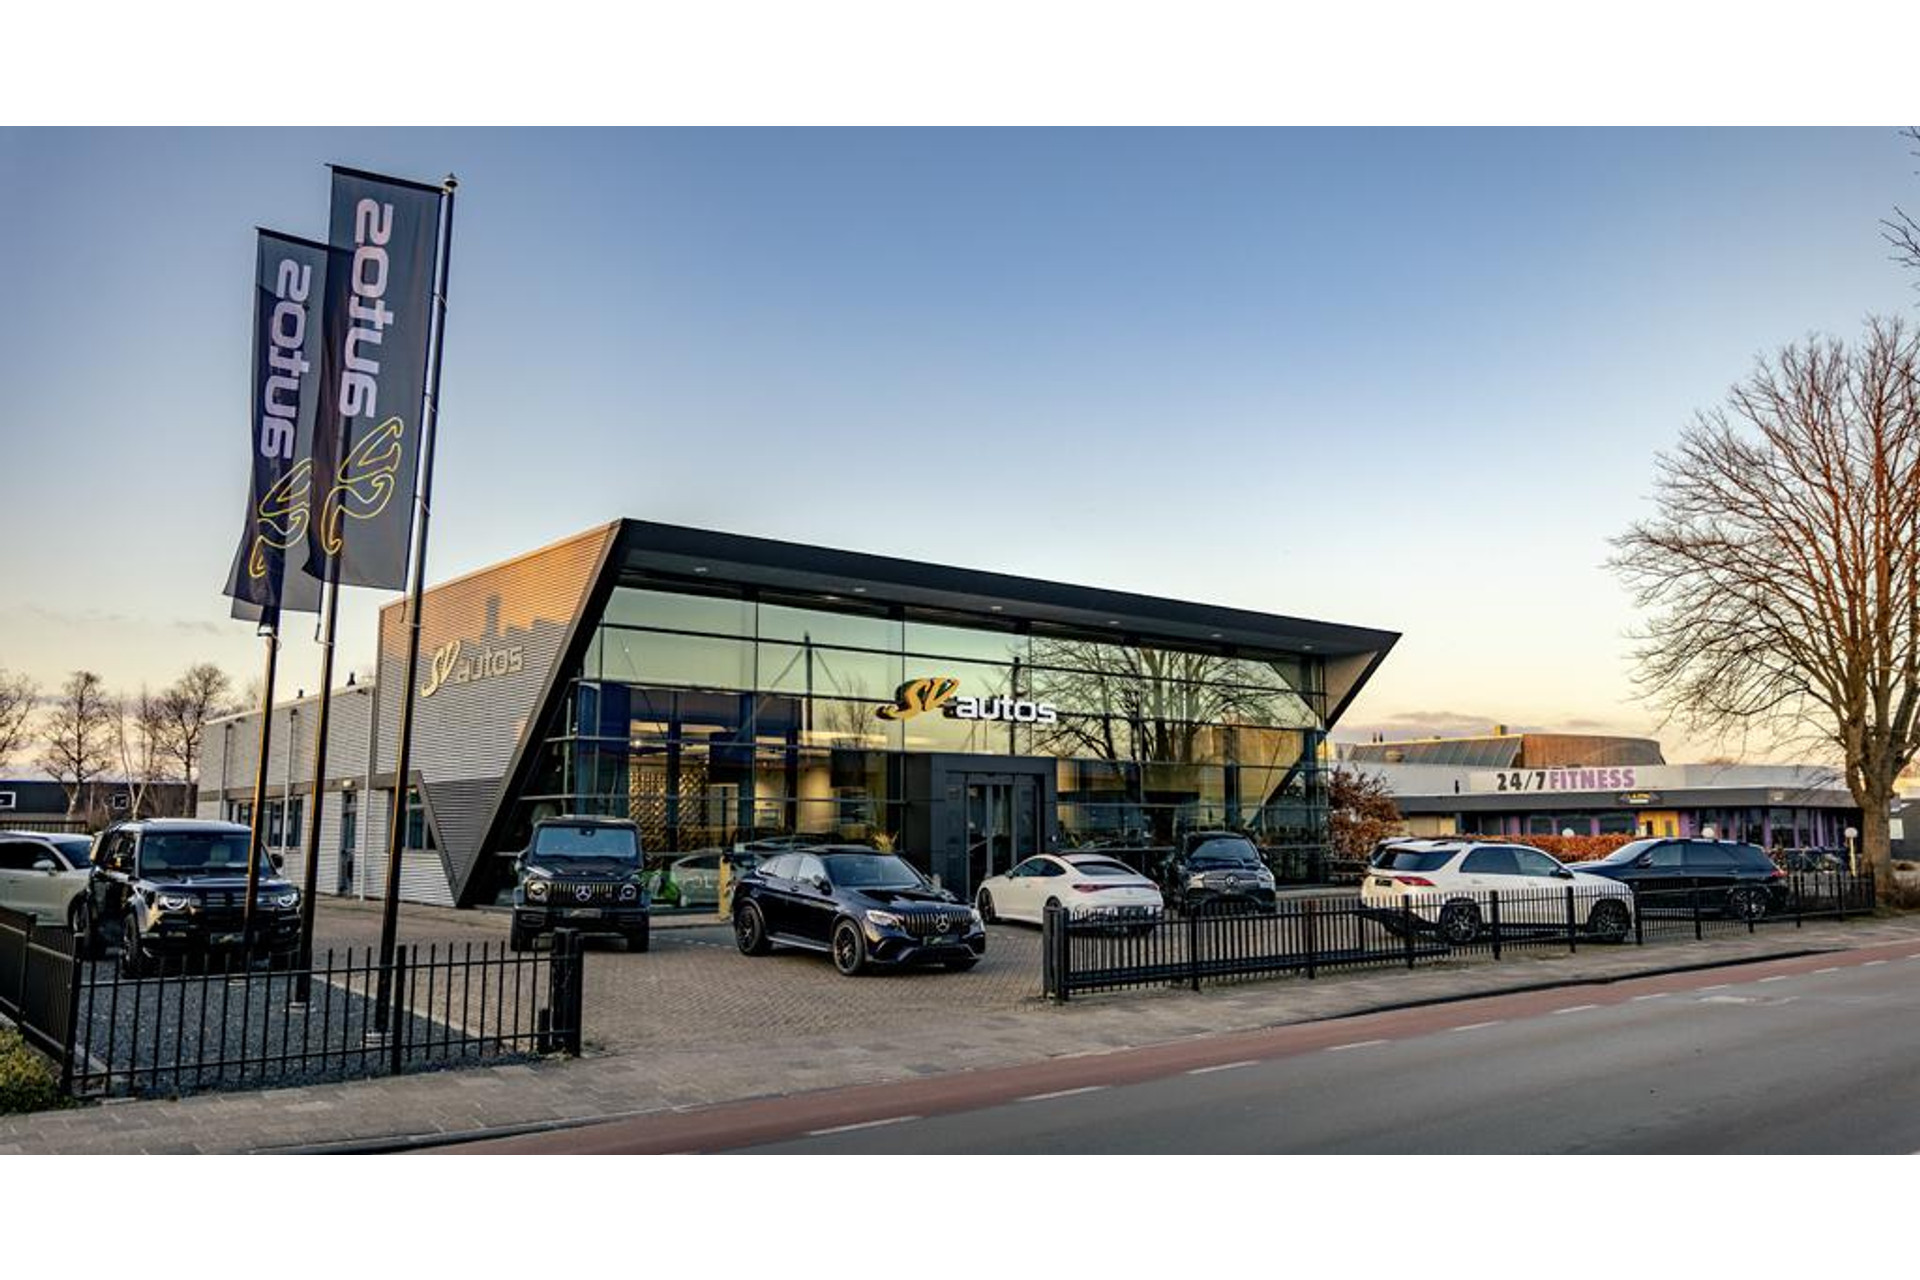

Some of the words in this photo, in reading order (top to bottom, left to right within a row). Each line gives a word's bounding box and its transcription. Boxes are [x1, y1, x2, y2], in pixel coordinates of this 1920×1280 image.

[457, 646, 523, 682] autos
[956, 696, 1057, 723] autos
[1497, 771, 1546, 791] 24/7
[1549, 769, 1636, 789] FITNESS
